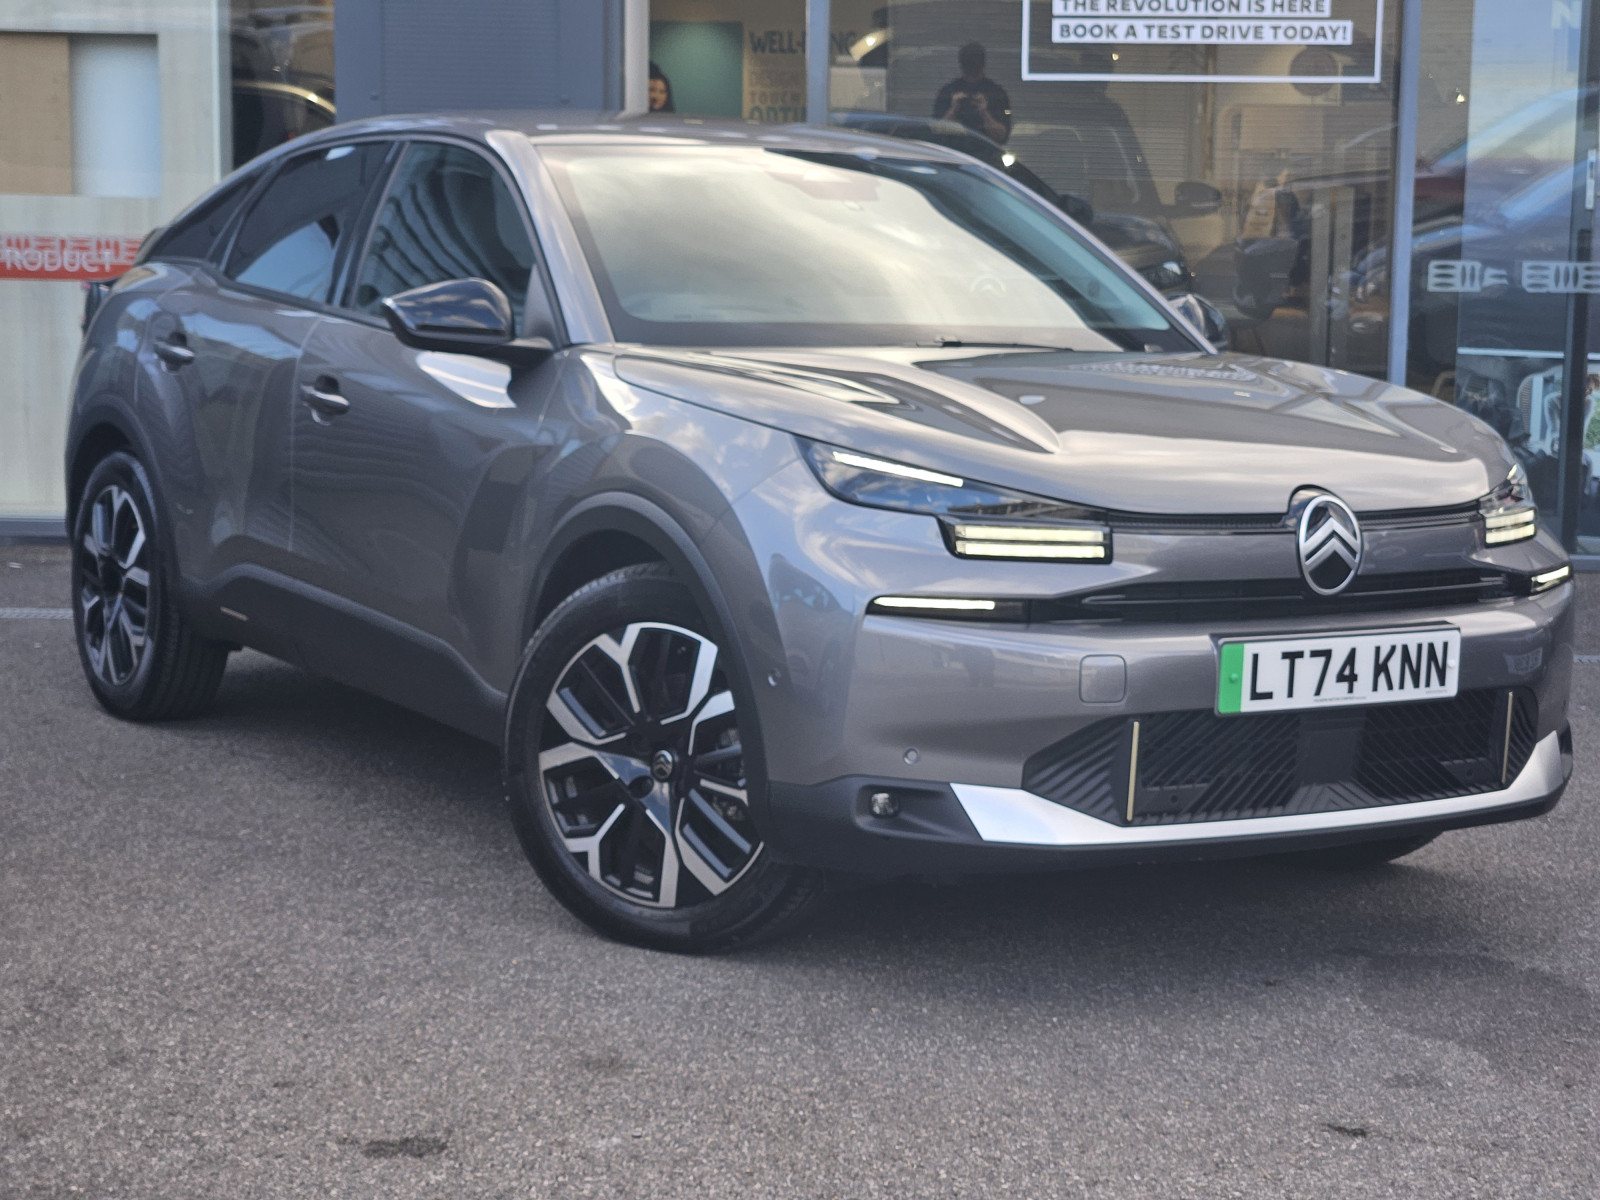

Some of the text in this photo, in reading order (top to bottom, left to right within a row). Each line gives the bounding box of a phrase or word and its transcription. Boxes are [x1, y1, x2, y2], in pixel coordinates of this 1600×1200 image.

[1061, 0, 1325, 13] THE REVOLUTION IS HERE
[1059, 24, 1347, 40] BOOK A TEST DRIVE TODAY!
[1249, 641, 1449, 701] LT74 KNN
